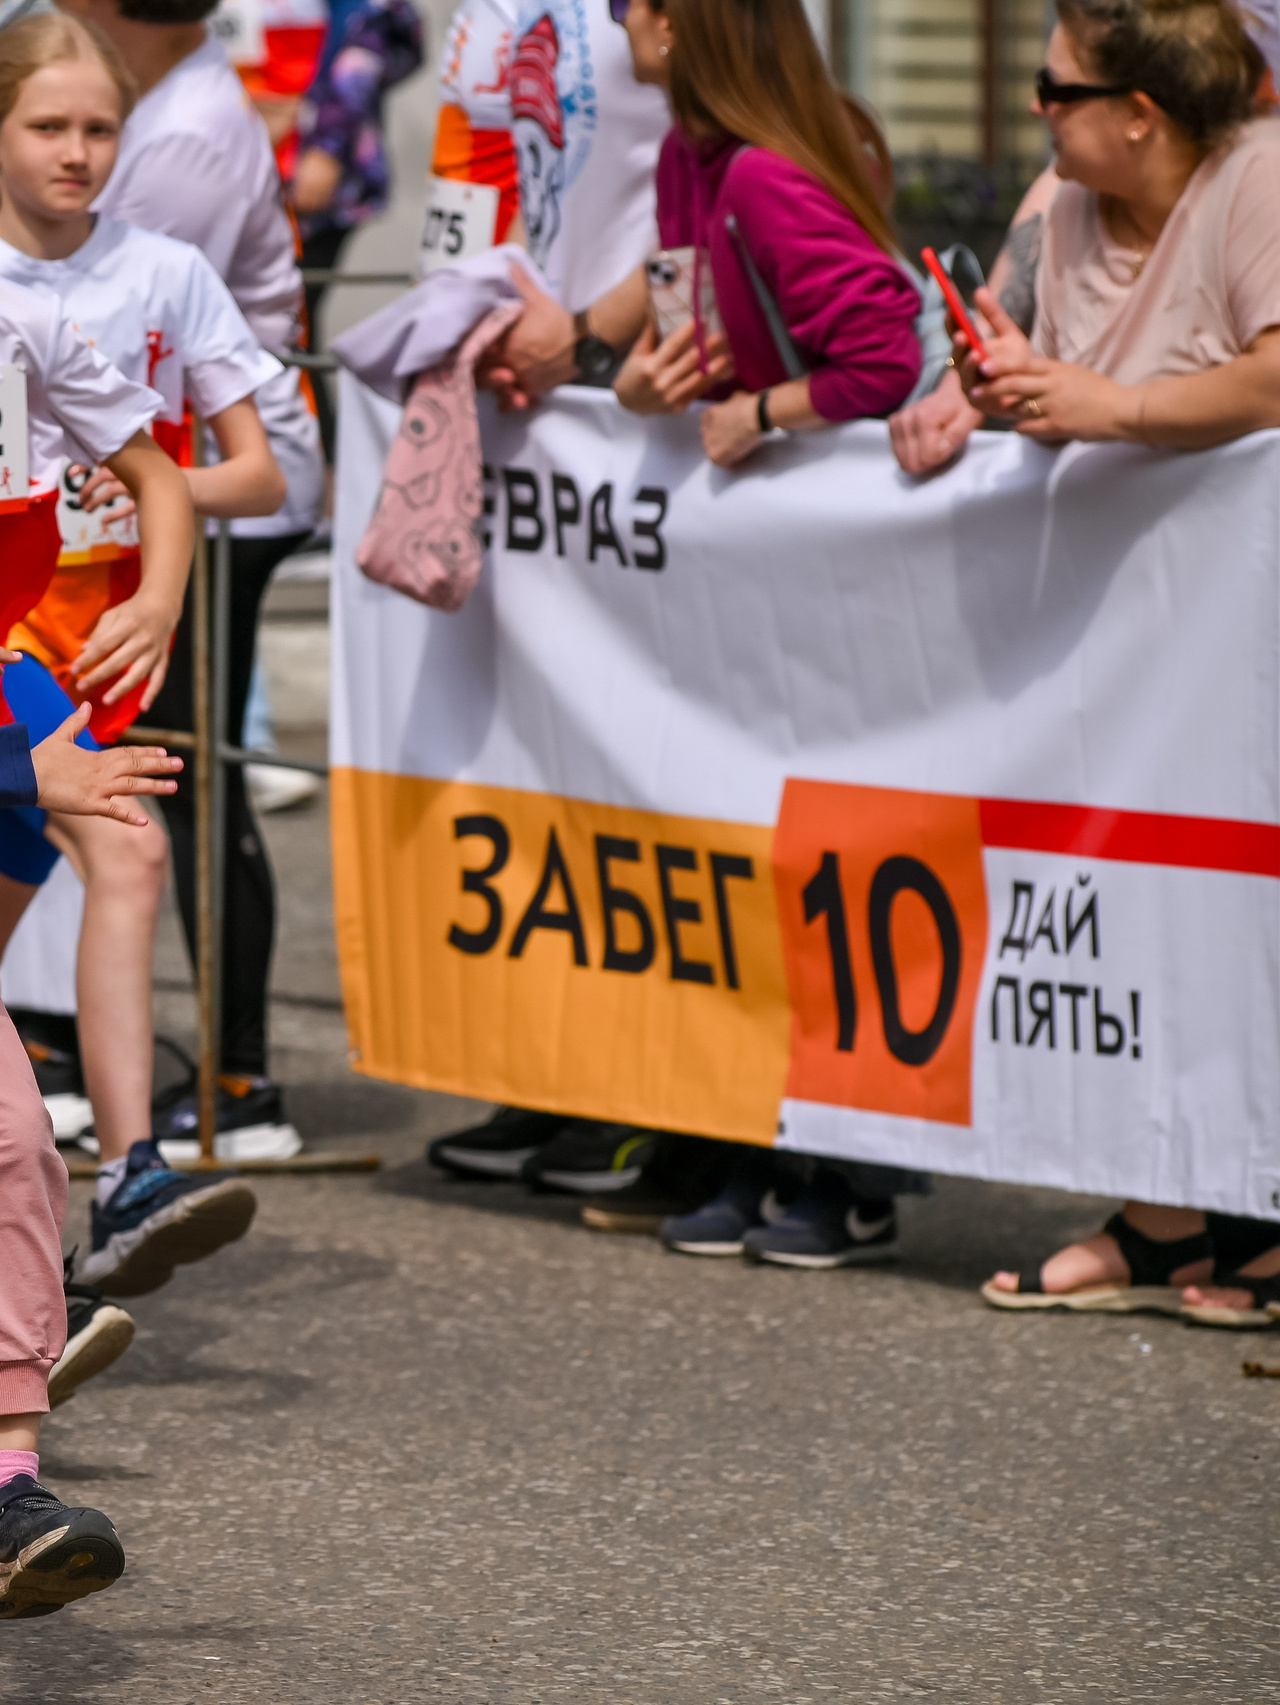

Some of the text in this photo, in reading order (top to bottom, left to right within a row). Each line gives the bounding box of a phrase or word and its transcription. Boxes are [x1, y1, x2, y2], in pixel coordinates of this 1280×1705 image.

[447, 813, 962, 1067] ЗАБЕГ 10
[998, 872, 1100, 962] ДАЙ
[991, 974, 1142, 1060] ПЯТЬ!
